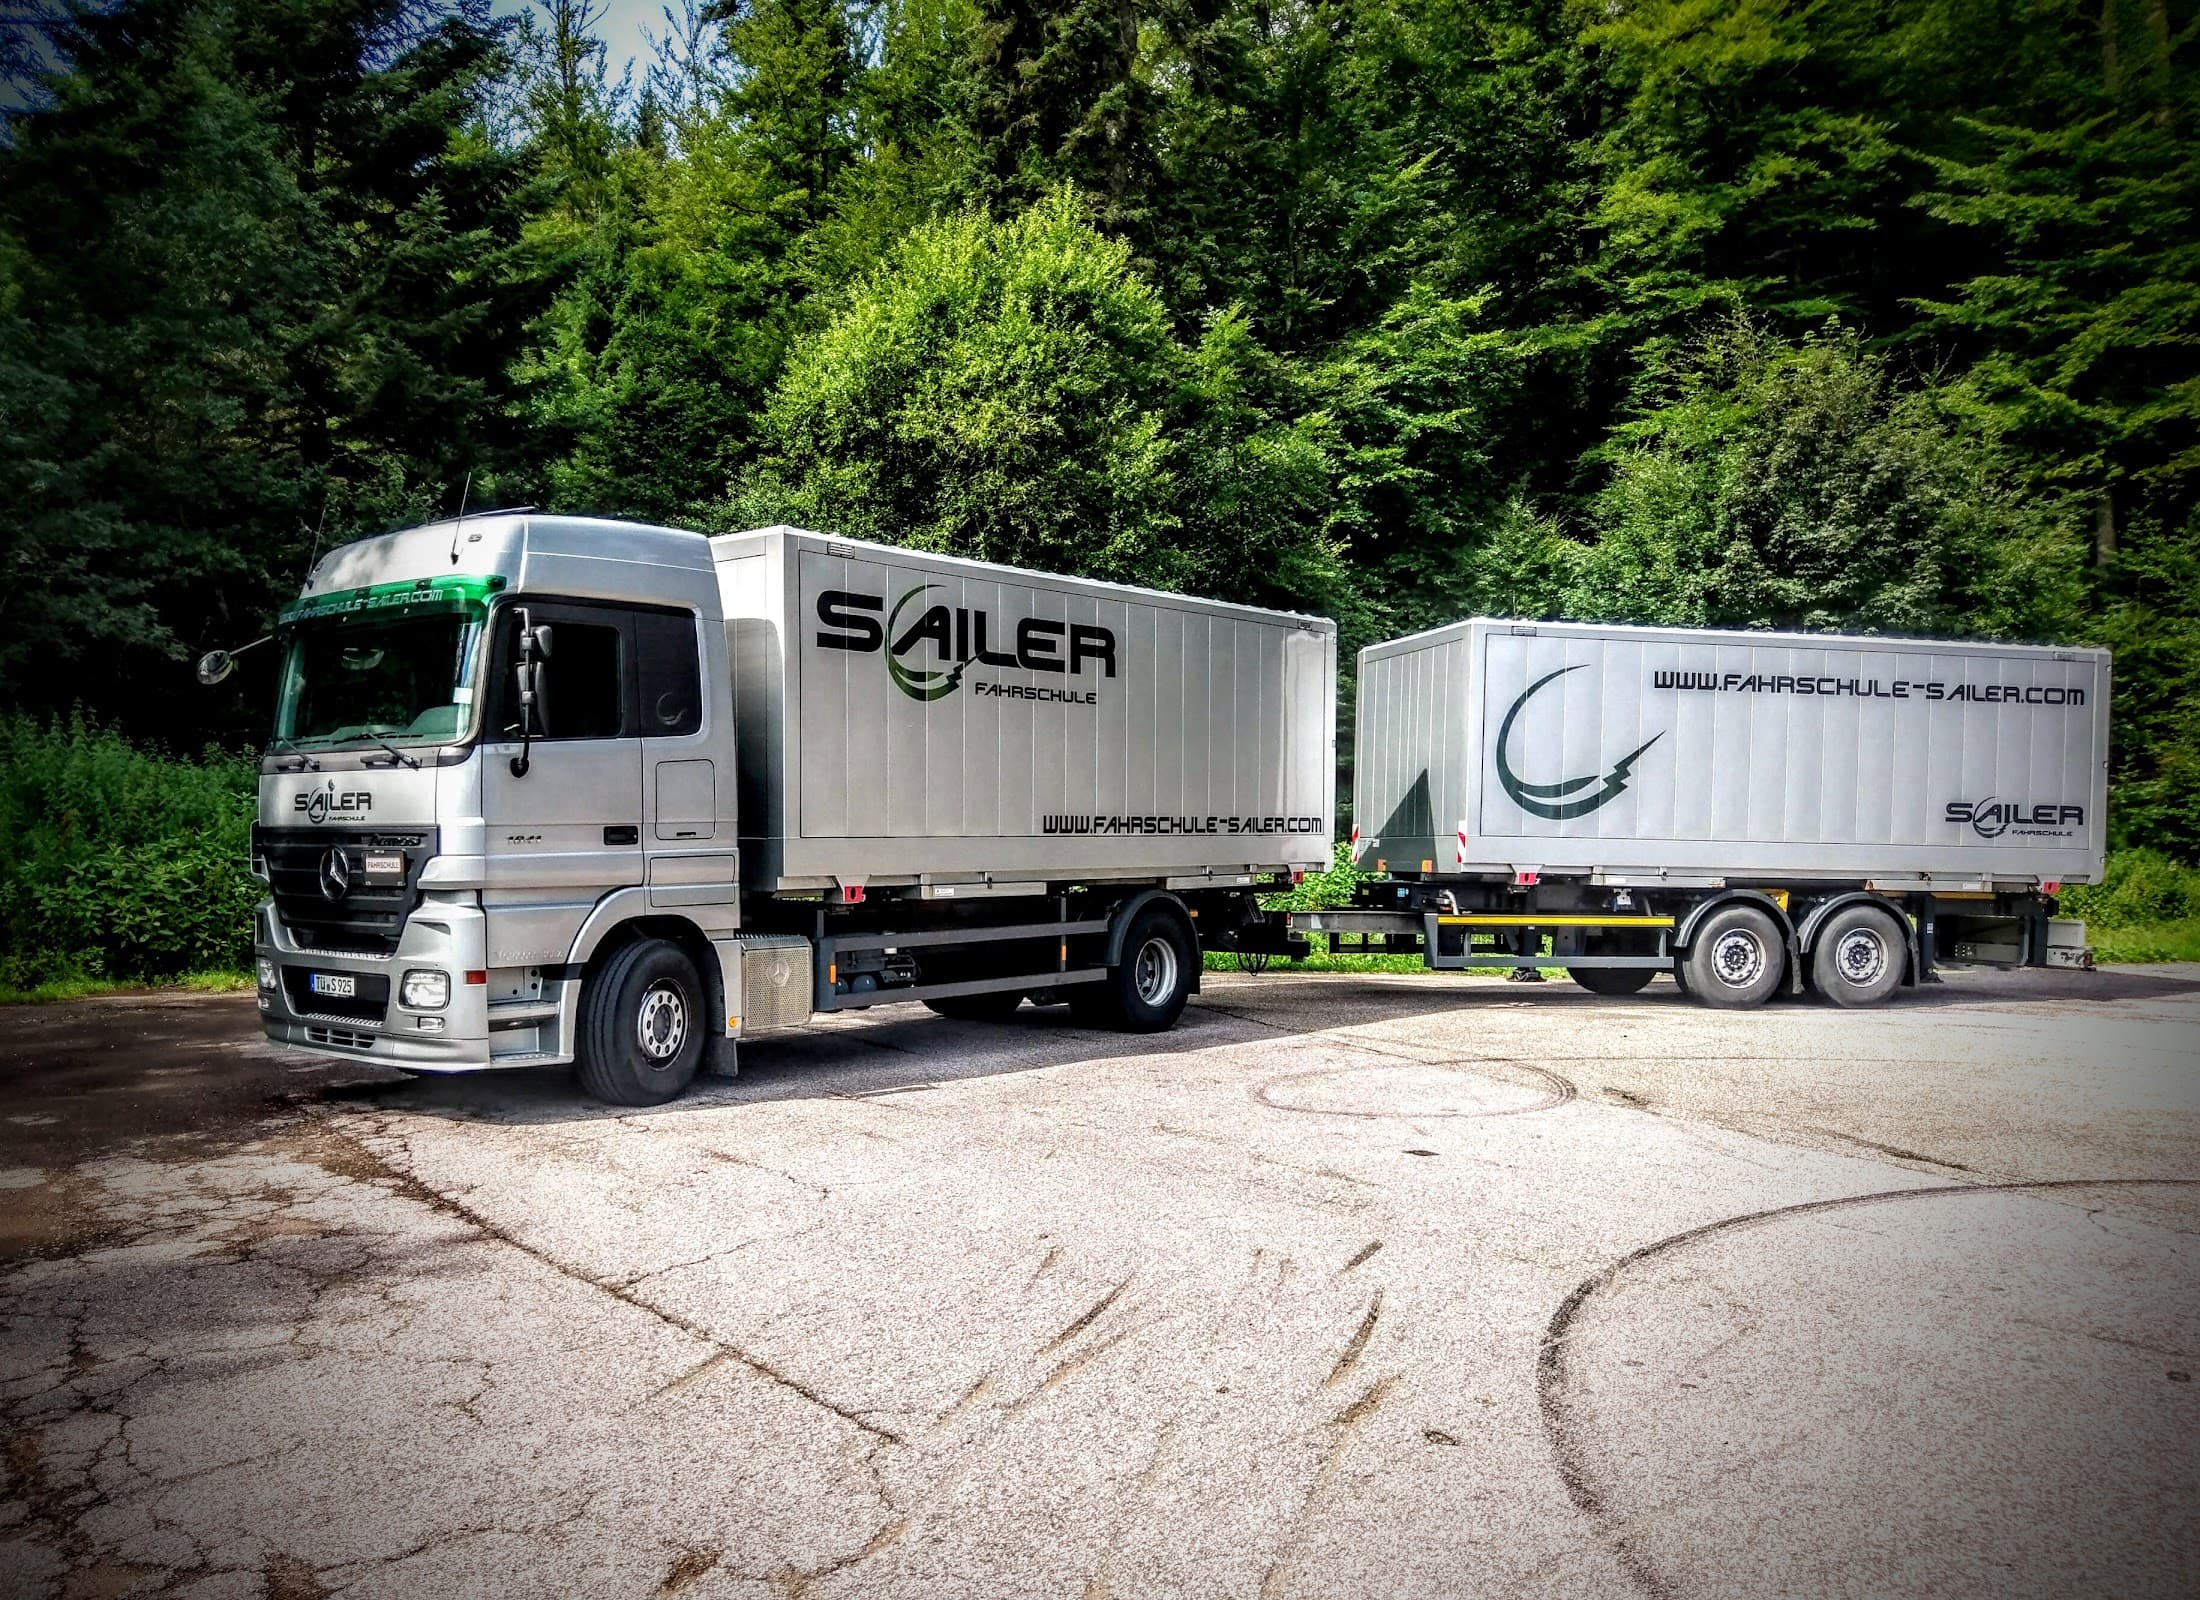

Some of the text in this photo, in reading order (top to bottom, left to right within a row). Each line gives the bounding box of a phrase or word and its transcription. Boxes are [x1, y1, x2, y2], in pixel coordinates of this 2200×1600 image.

[816, 590, 1116, 678] SAILER
[975, 682, 1097, 705] FAHRSCHULE
[1653, 669, 2086, 706] WWW.FAHRSCHULE-SAILER.COM
[294, 792, 372, 812] SAILER
[1042, 814, 1323, 834] WWW.FAHRSCHULE-SAILER.COM
[1945, 802, 2084, 826] SAILER
[2011, 829, 2074, 837] FAHRSCHULE
[367, 861, 400, 870] FAHRSCHULE
